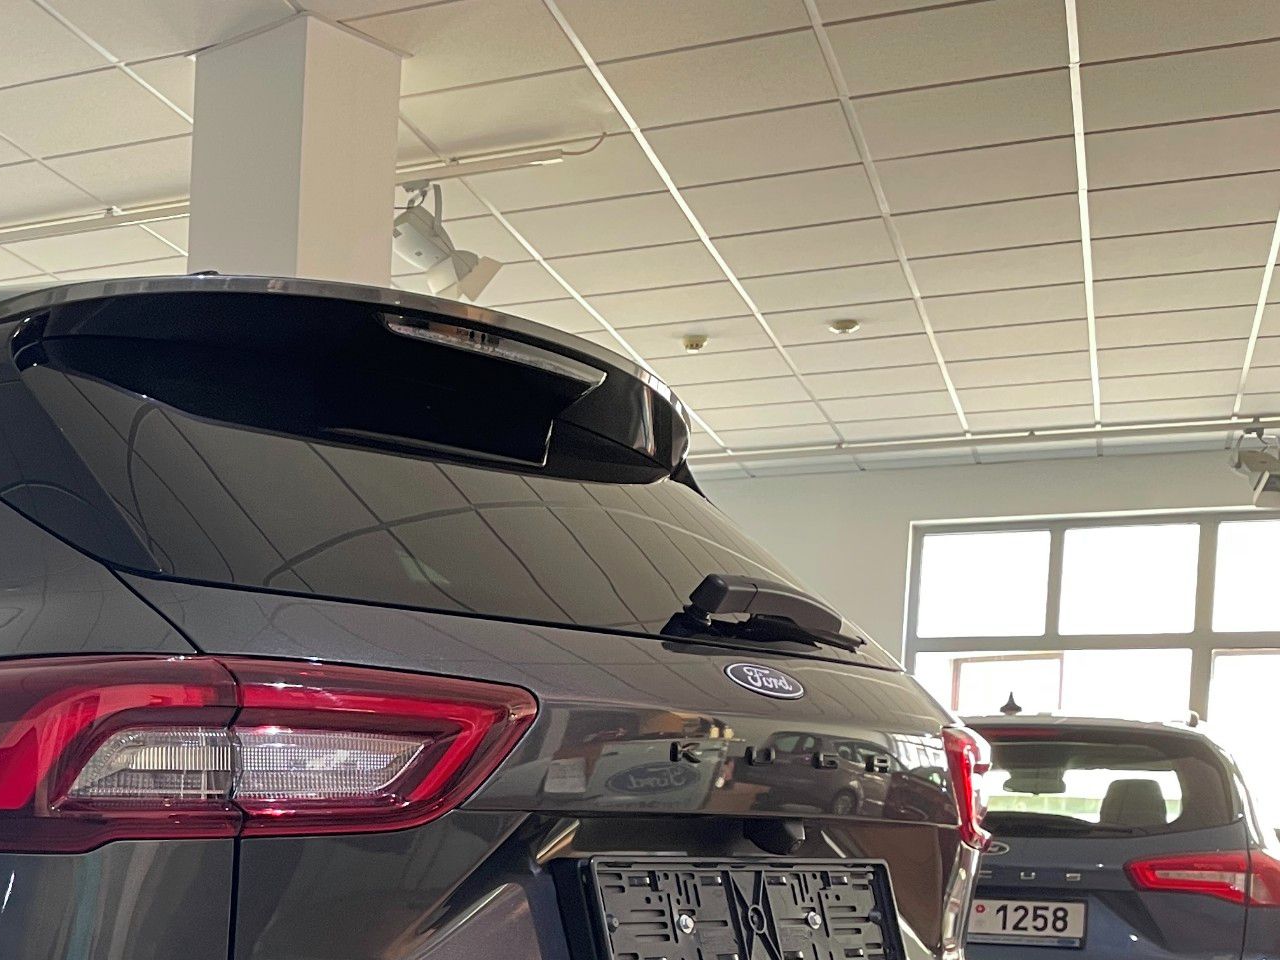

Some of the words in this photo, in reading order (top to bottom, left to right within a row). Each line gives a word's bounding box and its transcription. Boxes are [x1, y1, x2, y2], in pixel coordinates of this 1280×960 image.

[743, 664, 794, 692] Ford
[669, 740, 891, 774] KUGA
[995, 904, 1069, 933] 1258
